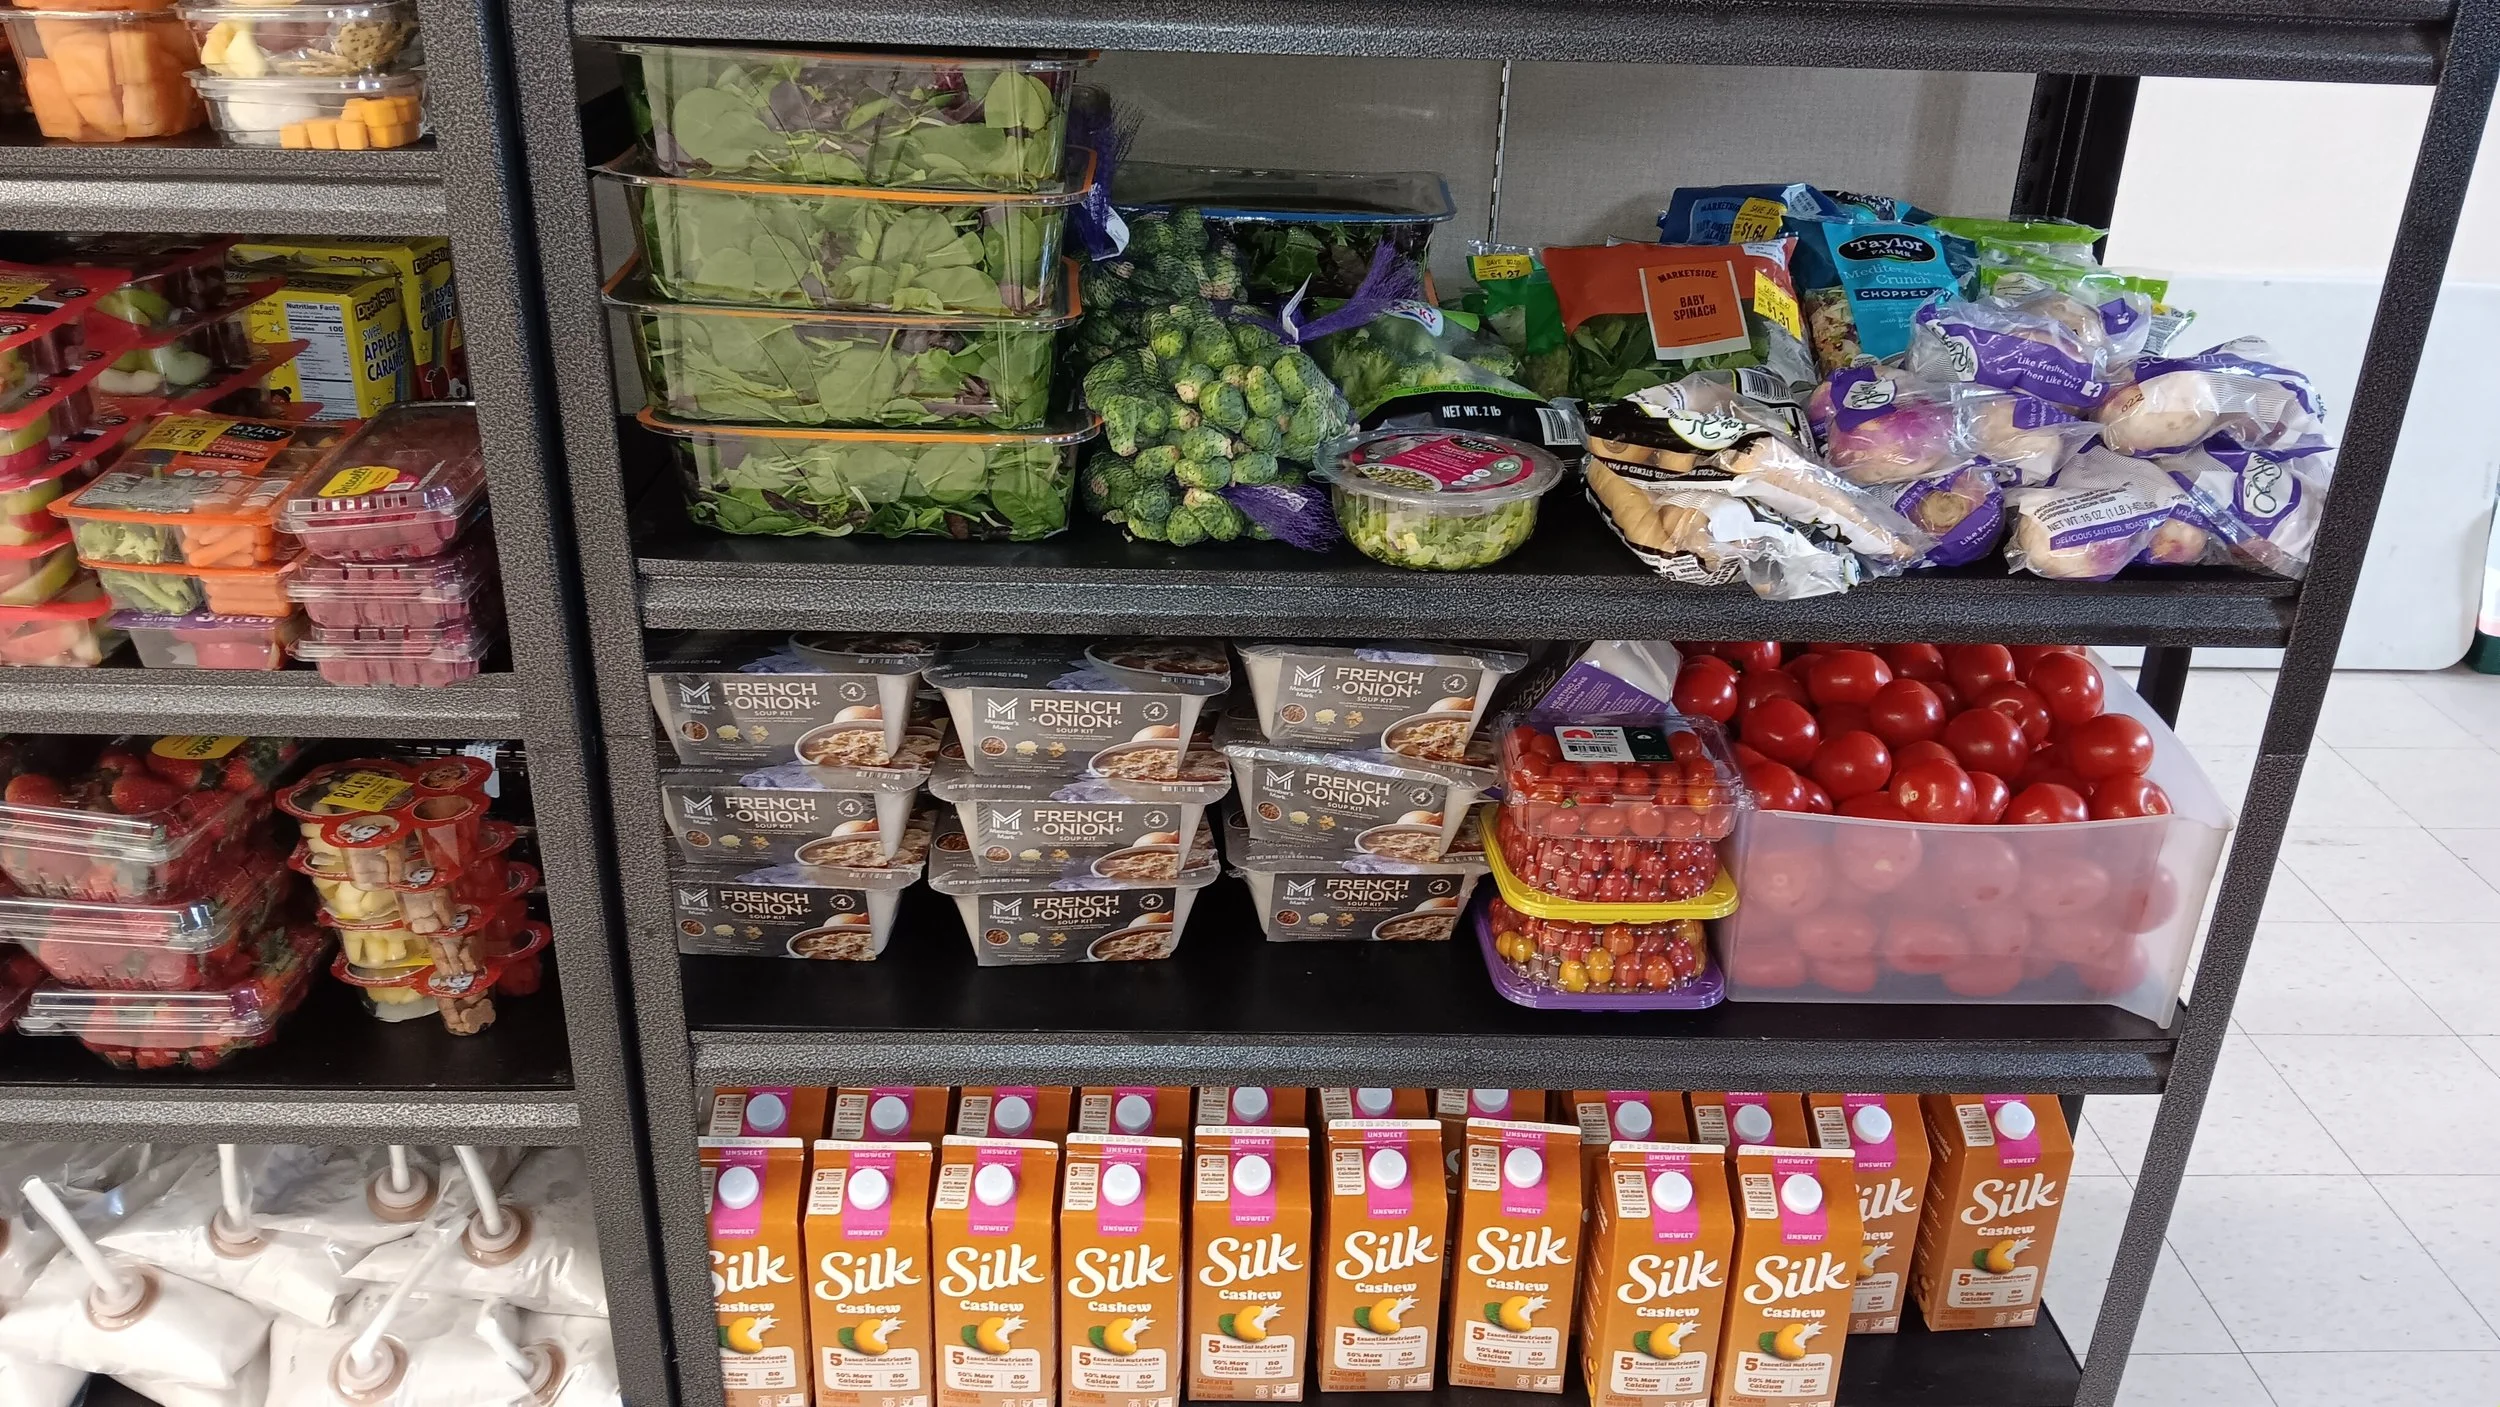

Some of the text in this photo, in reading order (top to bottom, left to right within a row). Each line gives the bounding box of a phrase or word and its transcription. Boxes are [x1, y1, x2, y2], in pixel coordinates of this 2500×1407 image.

[1741, 222, 1768, 241] $1.64
[1850, 237, 1924, 252] Taylor
[1871, 250, 1911, 258] FARMS
[1658, 269, 1719, 283] MARKETSIDE
[1875, 275, 1931, 285] Crunch
[1680, 295, 1705, 308] BABY
[1860, 290, 1929, 299] CHOPPED
[286, 303, 318, 311] Nutrition
[1673, 304, 1717, 321] SPINACH
[1766, 301, 1791, 331] $1.31
[2017, 355, 2082, 385] Like Freshness?
[2045, 375, 2062, 387] Like
[1442, 405, 1501, 418] NET WT. 2 lb
[233, 424, 286, 437] aylor
[2047, 520, 2065, 533] NET
[2080, 512, 2092, 525] 16
[2055, 530, 2093, 545] DELICIOUS
[1336, 667, 1425, 685] FRENCH
[723, 682, 818, 697] FRENCH
[847, 685, 858, 697] 4
[1342, 681, 1413, 698] ONION
[1449, 678, 1460, 690] 4
[734, 696, 811, 710] ONION
[1030, 699, 1122, 714] FRENCH
[1356, 696, 1378, 704] SOUP
[1149, 706, 1160, 718] 4
[1038, 713, 1113, 728] ONION
[1055, 727, 1079, 735] SOUP
[1305, 773, 1391, 796] FRENCH
[725, 796, 817, 811] FRENCH
[1311, 787, 1382, 808] ONION
[1416, 791, 1427, 802] 4
[844, 803, 856, 815] 4
[1327, 802, 1364, 813] SOUP KIT
[735, 809, 811, 825] ONION
[1033, 810, 1124, 825] FRENCH
[1149, 814, 1161, 825] 4
[754, 822, 777, 830] SOUP
[1043, 822, 1115, 837] ONION
[1326, 878, 1410, 892] FRENCH
[1433, 881, 1445, 892] 4
[720, 890, 810, 906] FRENCH
[1146, 897, 1157, 907] 4
[1333, 888, 1401, 902] ONION
[730, 902, 803, 916] ONION
[836, 897, 848, 908] 4
[1033, 895, 1120, 910] FRENCH
[1347, 900, 1369, 908] SOUP
[1040, 907, 1111, 922] ONION
[1856, 1178, 1917, 1222] ilk
[1961, 1173, 2059, 1226] Silk
[1862, 1231, 1893, 1240] hew
[1977, 1225, 2035, 1237] Cashew
[1335, 1225, 1441, 1280] Silk
[1467, 1226, 1573, 1275] Silk
[1198, 1233, 1305, 1287] Silk
[815, 1247, 922, 1300] Silk
[939, 1243, 1046, 1297] Silk
[1067, 1243, 1175, 1298] Silk
[1617, 1250, 1723, 1305] Silk
[1743, 1251, 1851, 1306] Silk
[1958, 1273, 1971, 1286] 5
[1354, 1282, 1418, 1294] Cashew
[1485, 1278, 1549, 1292] Cashew
[1218, 1289, 1283, 1301] Cashew
[836, 1302, 902, 1314] Cashew
[959, 1300, 1025, 1313] Cashew
[1088, 1301, 1152, 1313] Cashew
[1636, 1306, 1700, 1318] Cashew
[1762, 1307, 1826, 1319] Cashew
[1342, 1332, 1356, 1346] 5
[1472, 1327, 1485, 1340] 5
[1207, 1340, 1221, 1353] 5
[830, 1353, 843, 1366] 5
[952, 1352, 965, 1365] 5
[1078, 1352, 1091, 1366] 5
[1620, 1357, 1634, 1371] 5
[1744, 1357, 1759, 1371] 5
